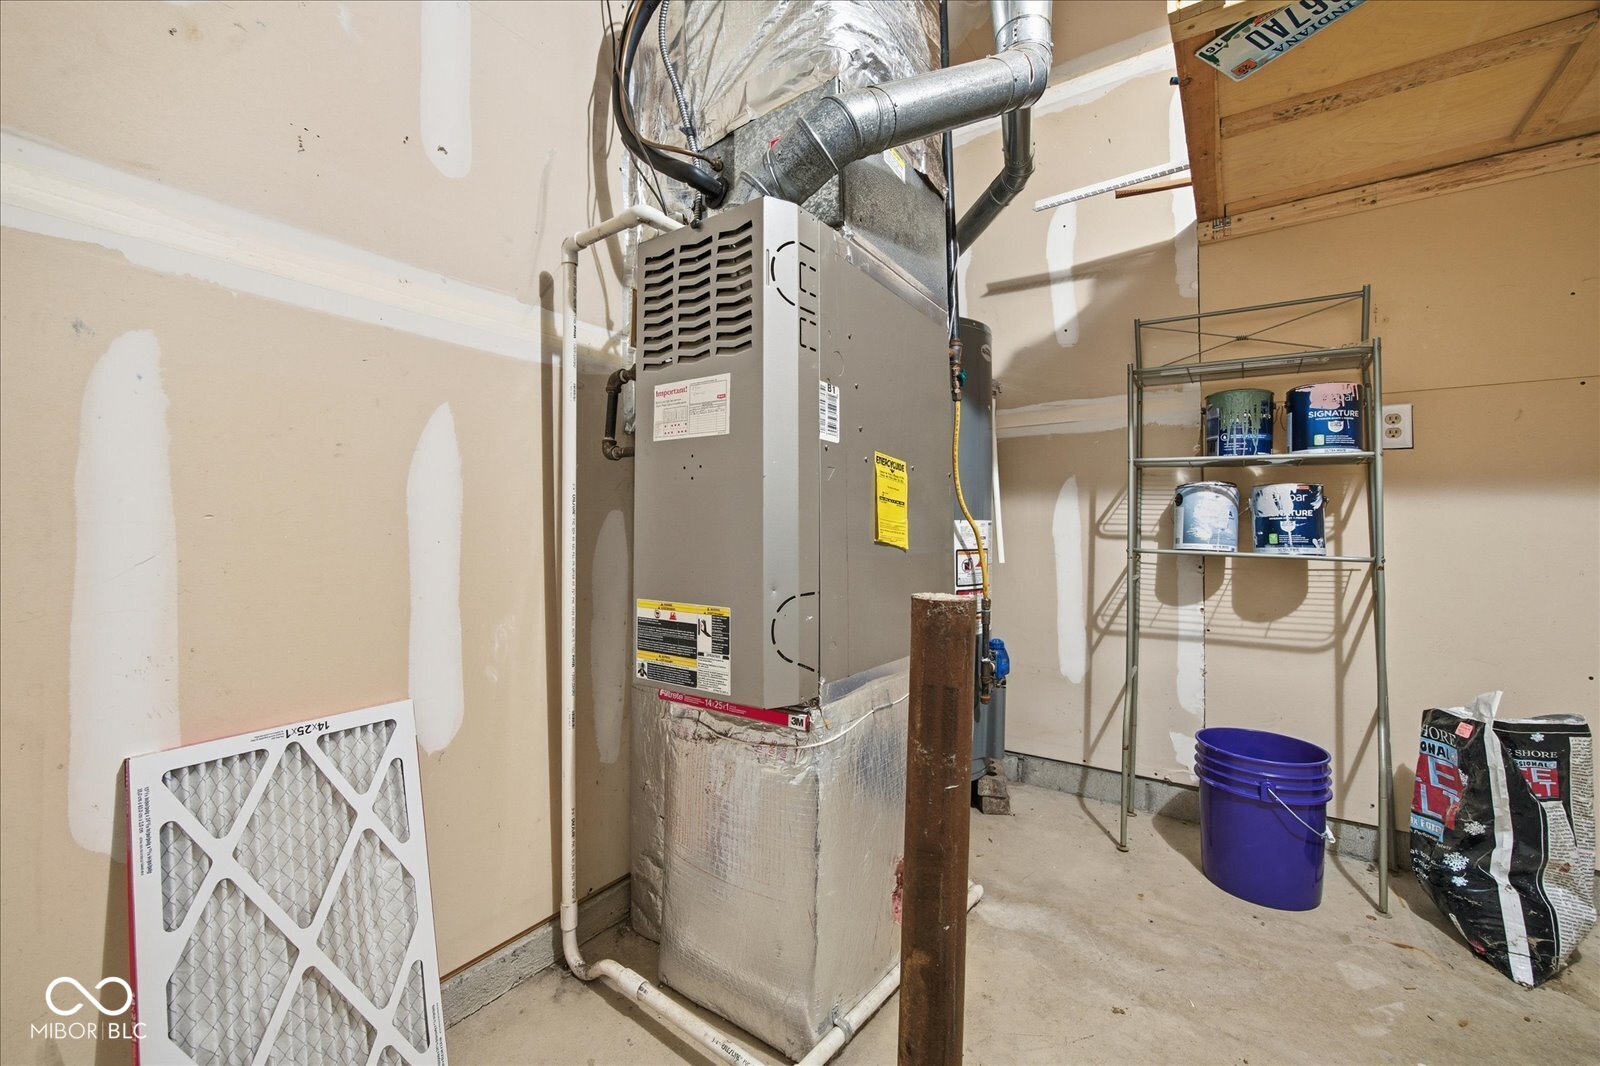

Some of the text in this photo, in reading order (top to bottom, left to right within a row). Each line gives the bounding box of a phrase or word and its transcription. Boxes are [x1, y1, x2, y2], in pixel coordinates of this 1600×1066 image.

[1271, 2, 1356, 53] INDIANA
[656, 386, 688, 398] Important!
[1308, 409, 1359, 418] SIGNATURE
[659, 688, 684, 701] Filtrete
[791, 716, 804, 727] 3M
[1514, 749, 1559, 759] SHORE
